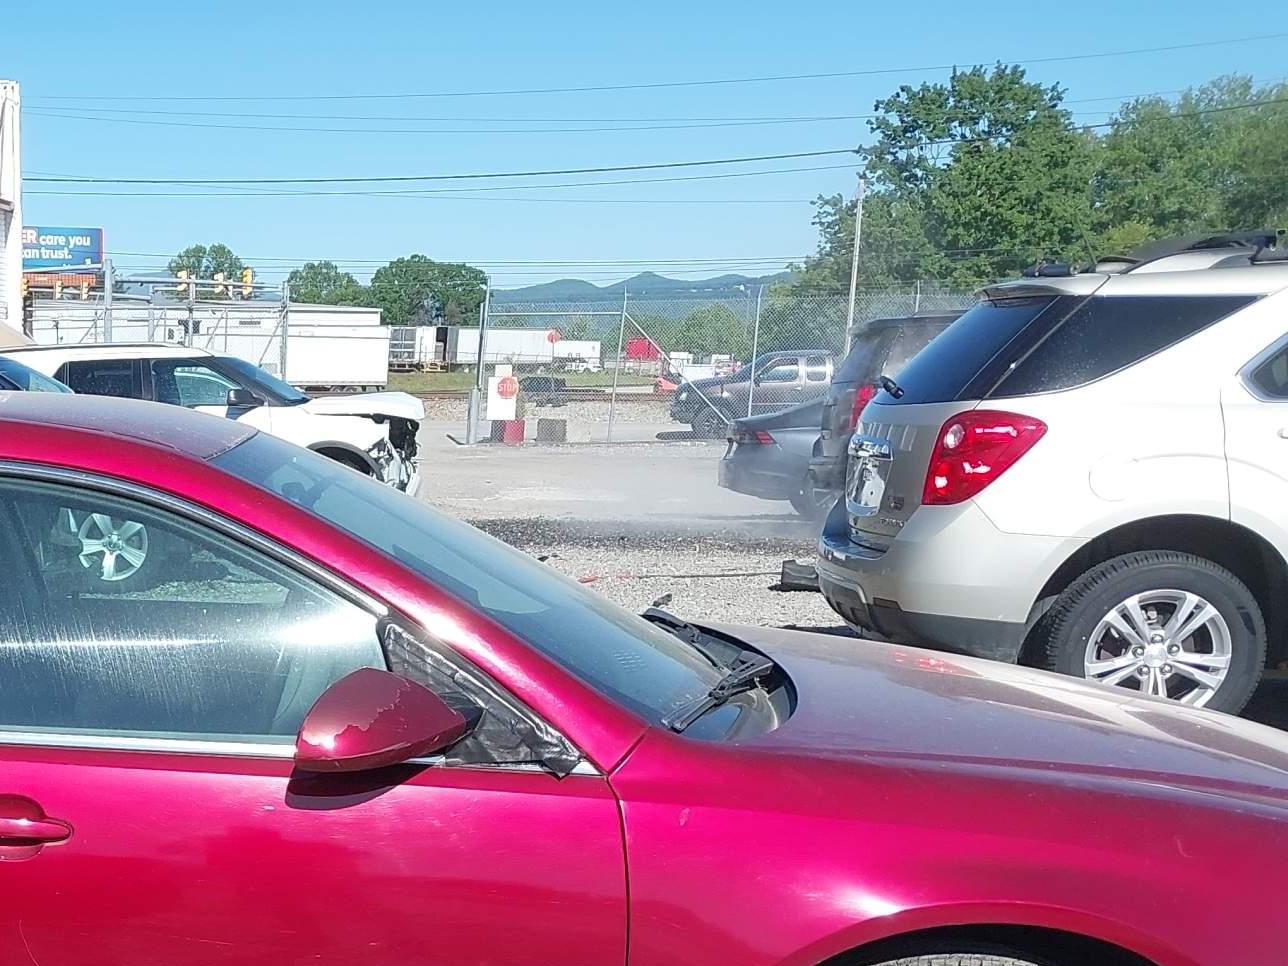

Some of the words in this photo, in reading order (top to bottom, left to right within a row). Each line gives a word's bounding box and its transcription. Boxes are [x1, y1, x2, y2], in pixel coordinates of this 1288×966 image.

[39, 234, 66, 246] care
[68, 235, 91, 249] you
[40, 247, 73, 259] trust.
[498, 383, 518, 392] STOP
